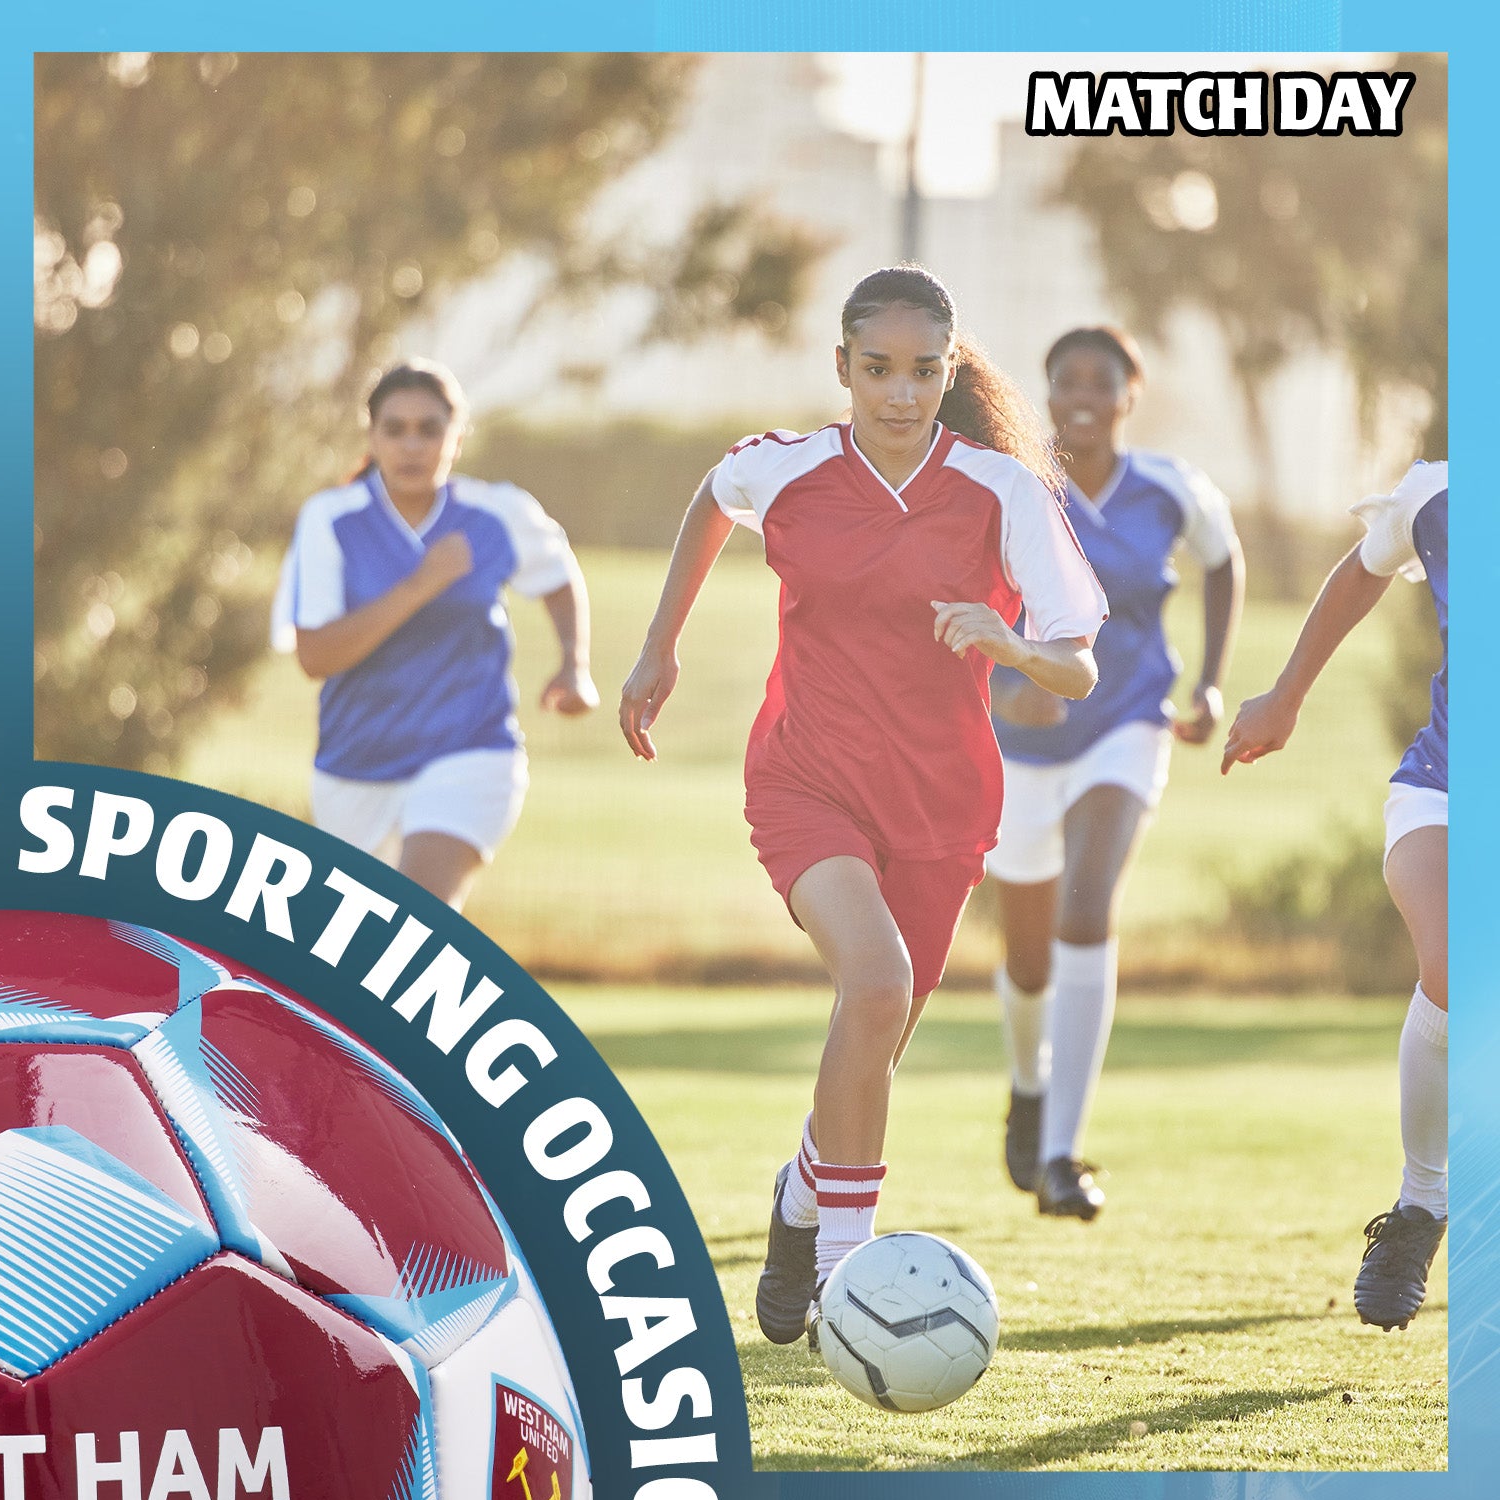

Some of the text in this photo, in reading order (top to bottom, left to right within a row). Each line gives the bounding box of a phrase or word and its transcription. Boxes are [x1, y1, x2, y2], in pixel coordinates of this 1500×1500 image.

[503, 1391, 569, 1460] WEST HAM
[520, 1422, 559, 1463] UNITED
